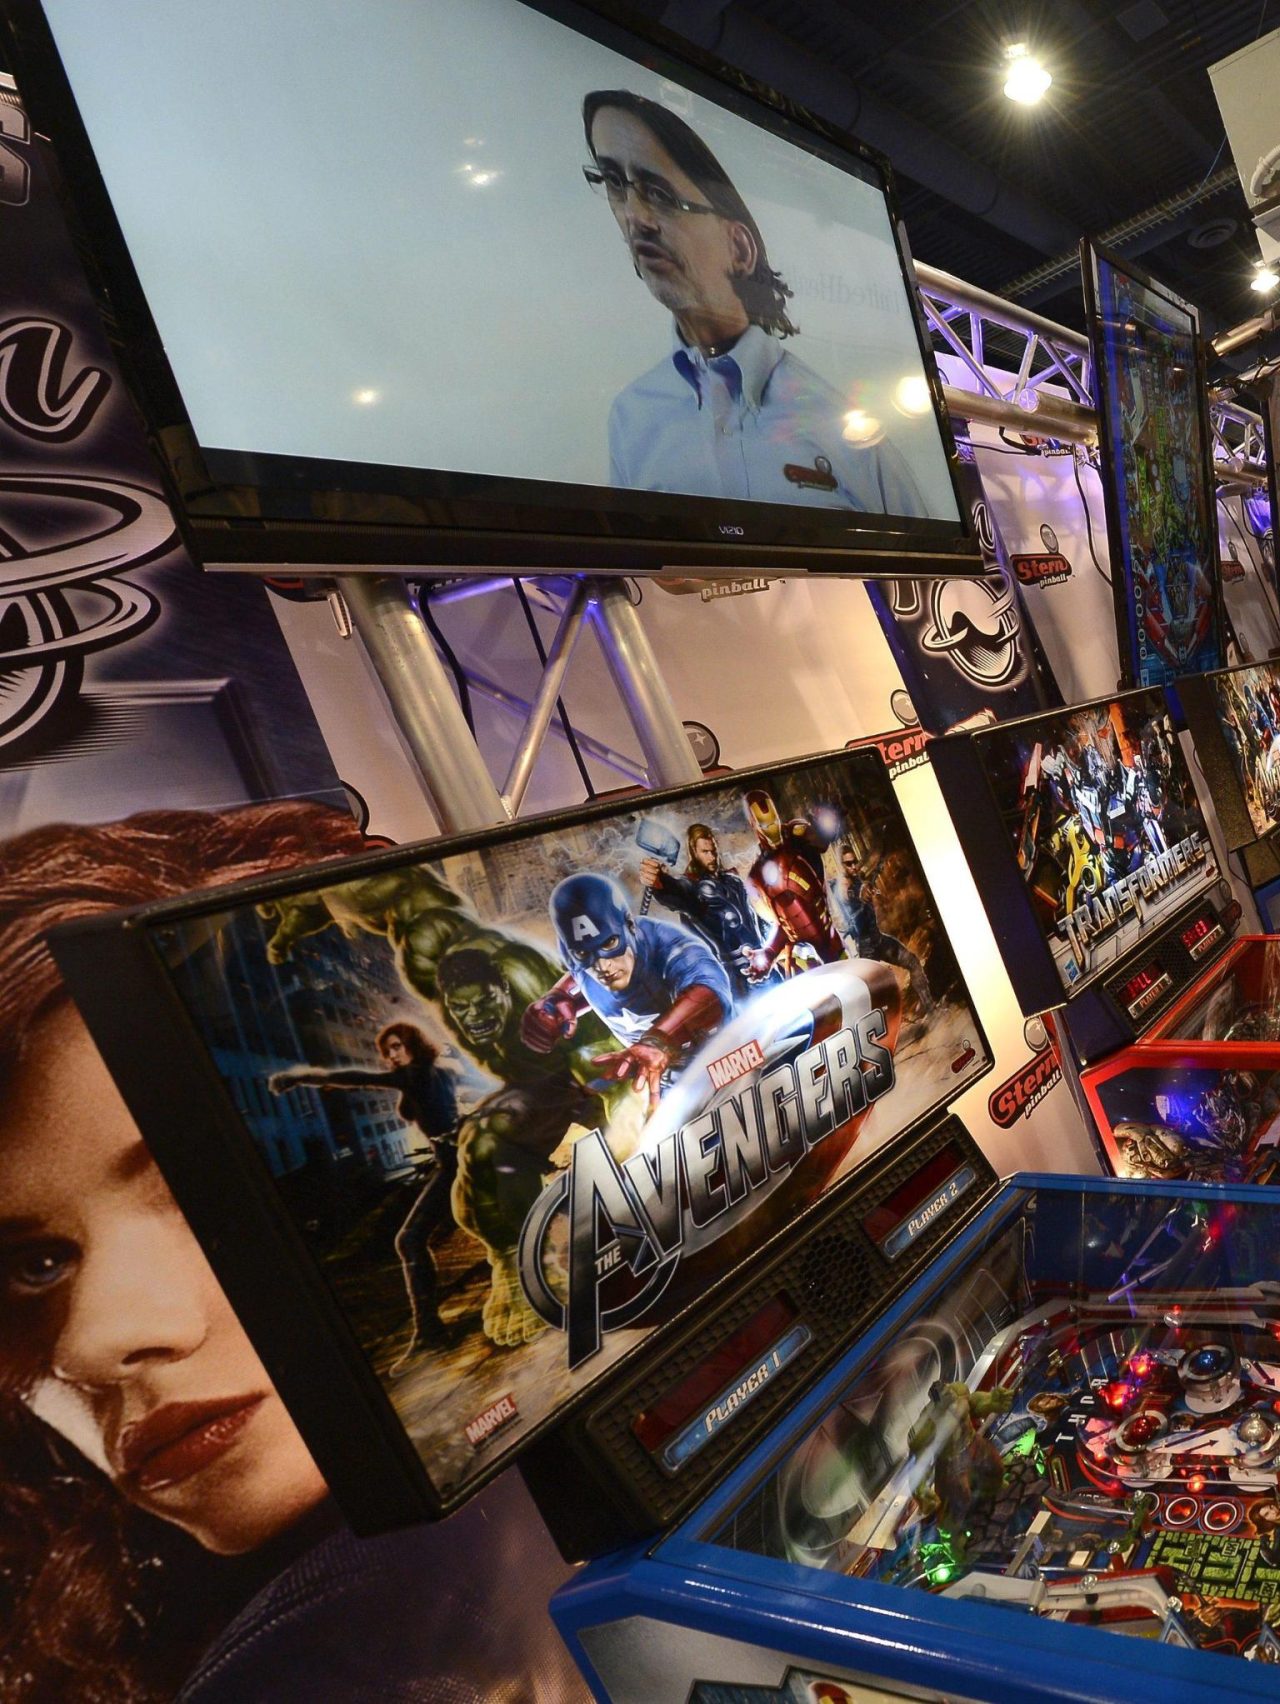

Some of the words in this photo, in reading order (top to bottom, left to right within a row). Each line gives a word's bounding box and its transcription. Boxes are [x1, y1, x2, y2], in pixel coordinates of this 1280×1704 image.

[718, 525, 744, 536] VIZIO
[1017, 559, 1067, 579] Stern
[1040, 573, 1067, 588] pinball
[701, 578, 767, 600] pinball
[876, 732, 928, 765] tern
[889, 751, 930, 780] pinbal
[1057, 831, 1204, 966] TRANSFORMERS
[1139, 989, 1160, 1009] PLAYER
[707, 1039, 766, 1089] MARVEL
[998, 1053, 1058, 1113] Stern
[1025, 1069, 1061, 1118] pinball
[567, 1008, 896, 1371] AVENGERS
[908, 1193, 948, 1237] PLAYER
[949, 1182, 959, 1197] 2
[595, 1250, 621, 1275] THE
[704, 1363, 769, 1433] PLAYER
[771, 1351, 781, 1369] 1
[465, 1397, 516, 1443] MARVEL
